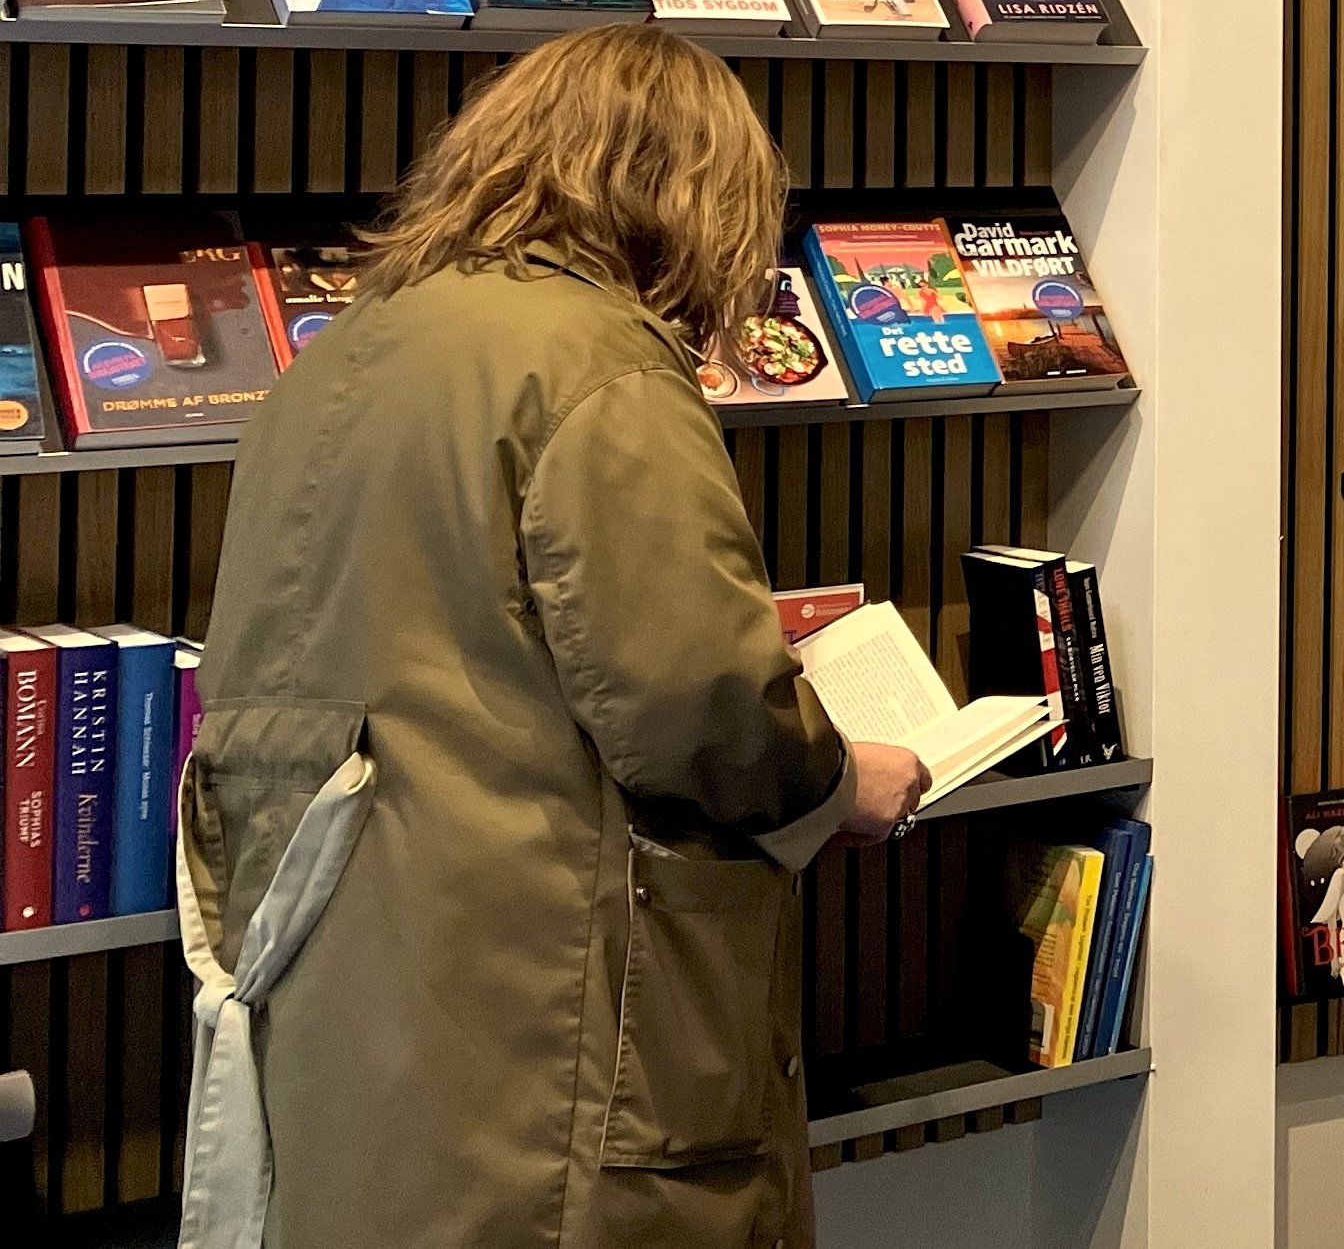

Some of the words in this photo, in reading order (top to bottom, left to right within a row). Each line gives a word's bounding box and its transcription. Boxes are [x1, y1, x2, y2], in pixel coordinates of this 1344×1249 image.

[703, 0, 778, 12] SYGDOM
[998, 2, 1036, 15] LISA
[1039, 2, 1098, 15] RIDZÉN
[819, 223, 859, 233] SOPHIA
[860, 223, 941, 233] MONEY-COUTTS
[963, 223, 1015, 241] David
[955, 230, 1078, 257] Garmark
[972, 257, 1075, 278] VILDFØRT
[883, 326, 904, 336] Det
[879, 330, 973, 358] rette
[904, 354, 968, 377] sted
[103, 398, 177, 412] DRØMME
[182, 395, 204, 407] AF
[208, 391, 270, 405] BRONZ
